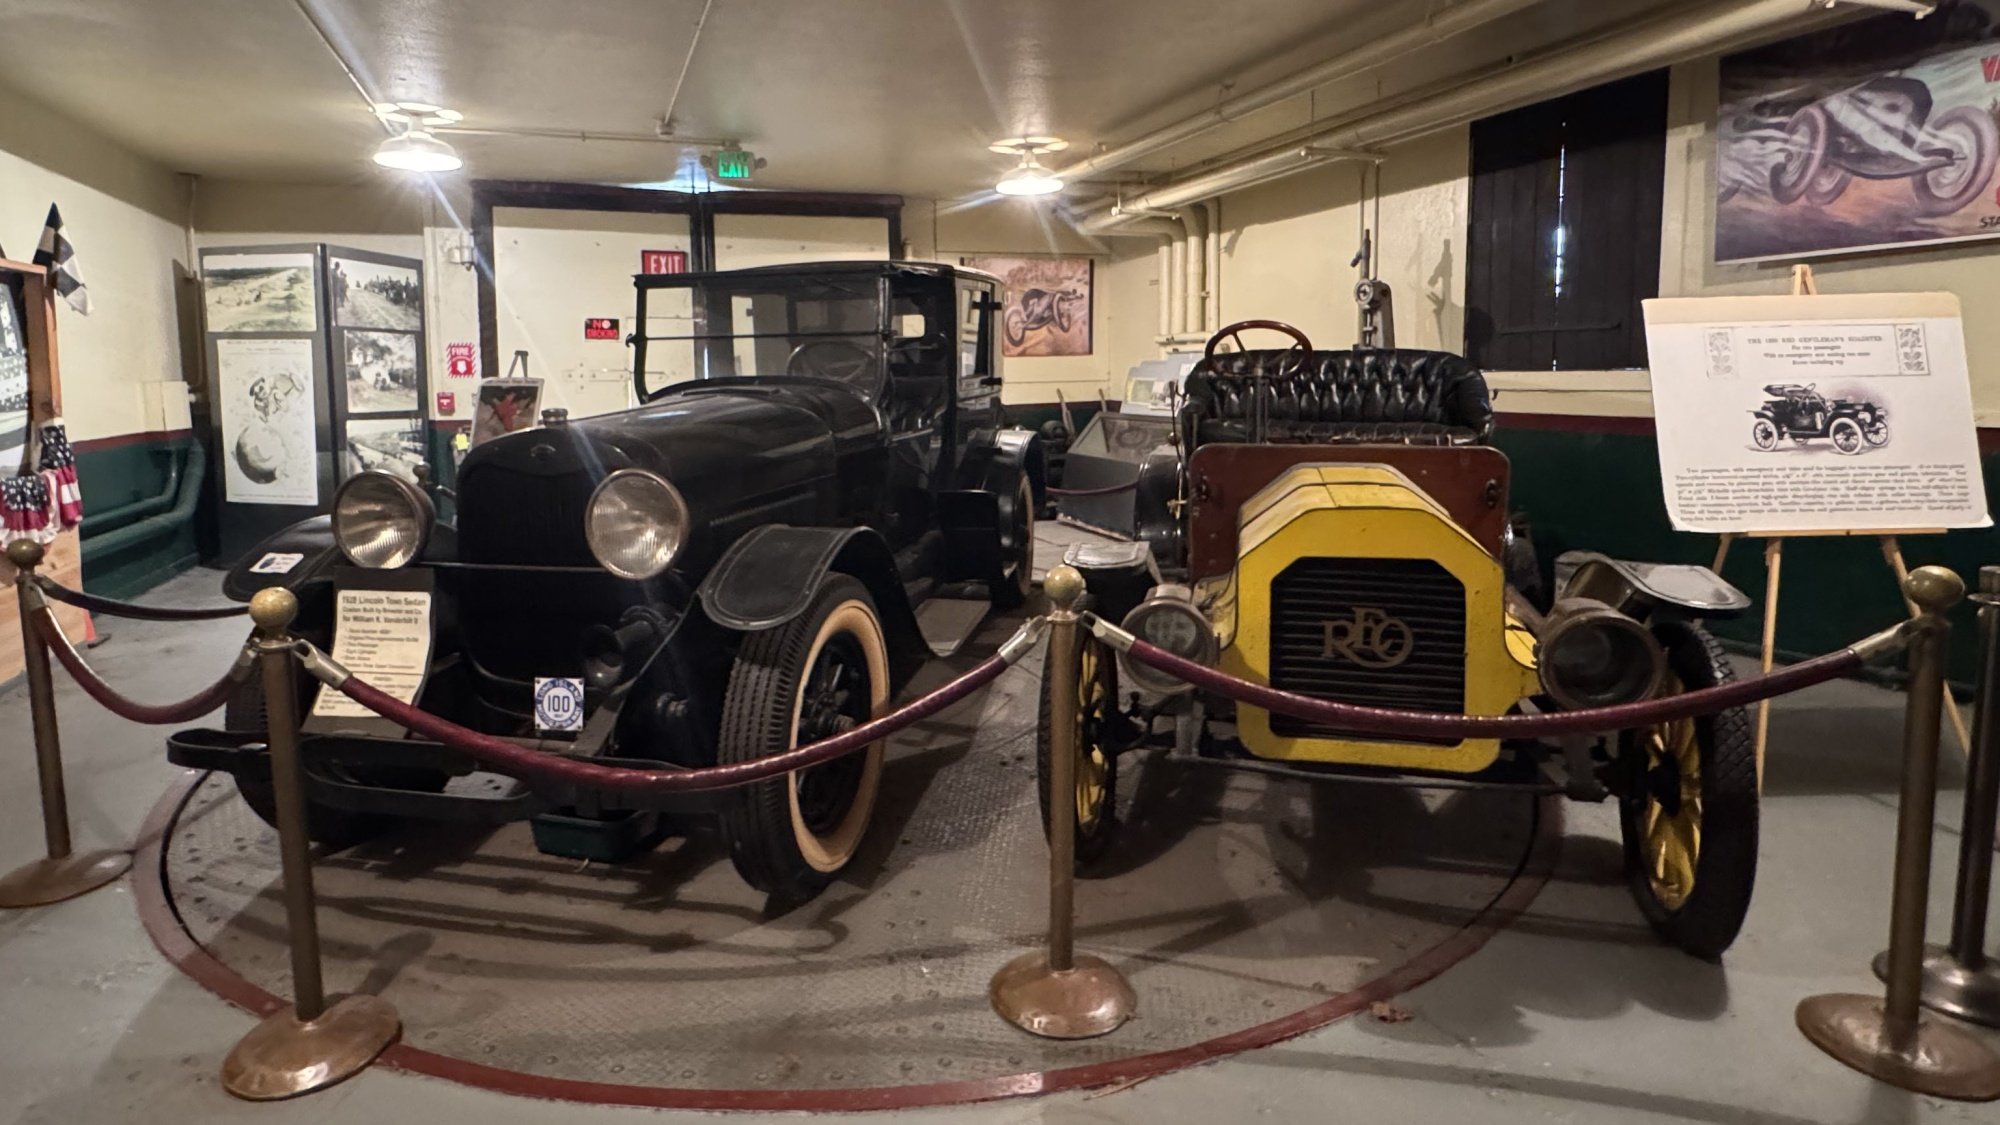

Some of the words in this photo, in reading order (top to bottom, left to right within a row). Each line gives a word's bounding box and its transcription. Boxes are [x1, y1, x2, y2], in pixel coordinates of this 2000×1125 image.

[718, 152, 749, 178] EXIT
[650, 255, 680, 274] EXIT
[592, 320, 611, 329] NO
[452, 347, 470, 356] FIRE
[359, 596, 384, 604] Lincoln
[386, 597, 402, 605] Town
[404, 597, 426, 606] Sedan
[548, 695, 570, 712] 100
